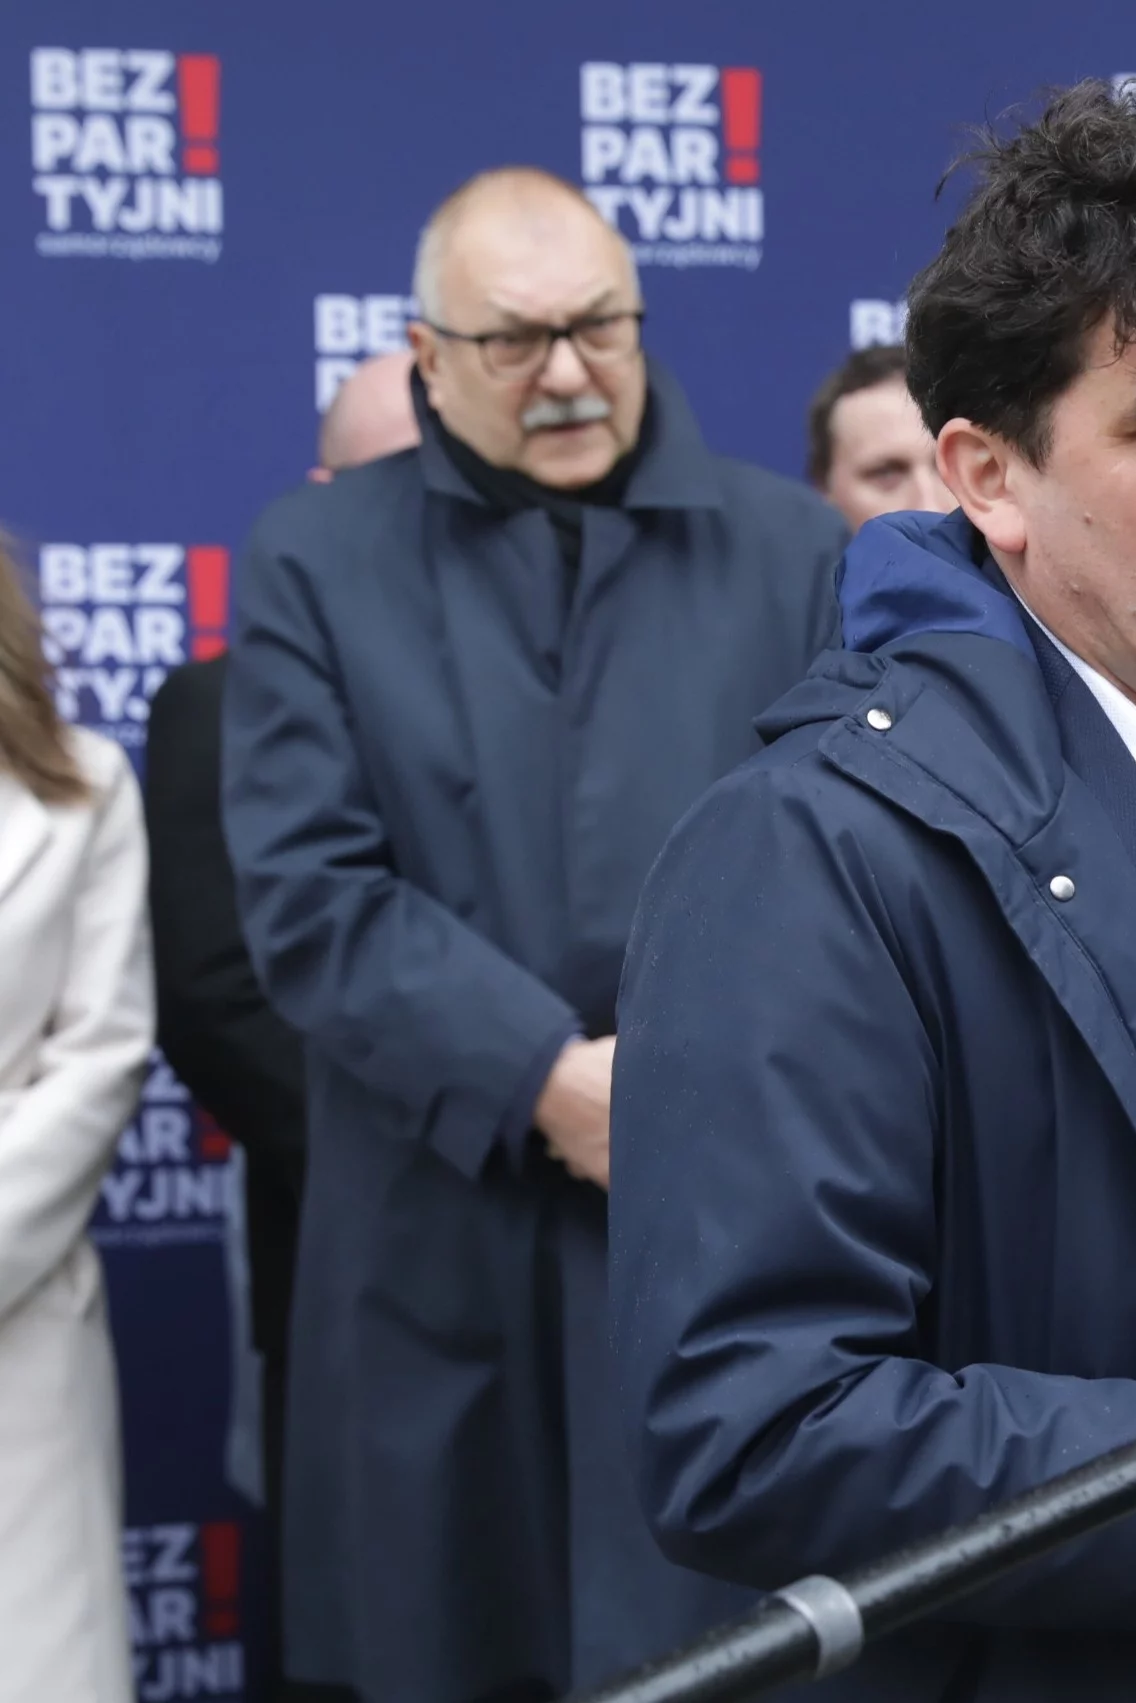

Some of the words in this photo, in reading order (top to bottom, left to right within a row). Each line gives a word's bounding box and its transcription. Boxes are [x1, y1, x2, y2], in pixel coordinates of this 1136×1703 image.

[30, 46, 175, 112] BEZ
[580, 61, 719, 124] BEZ
[31, 112, 175, 174] PAR
[581, 126, 718, 184] PAR
[32, 174, 223, 233] TYJNI
[584, 186, 764, 242] TYJNI
[314, 293, 422, 355] BE
[39, 543, 186, 604] BEZ
[40, 604, 187, 666] PAR
